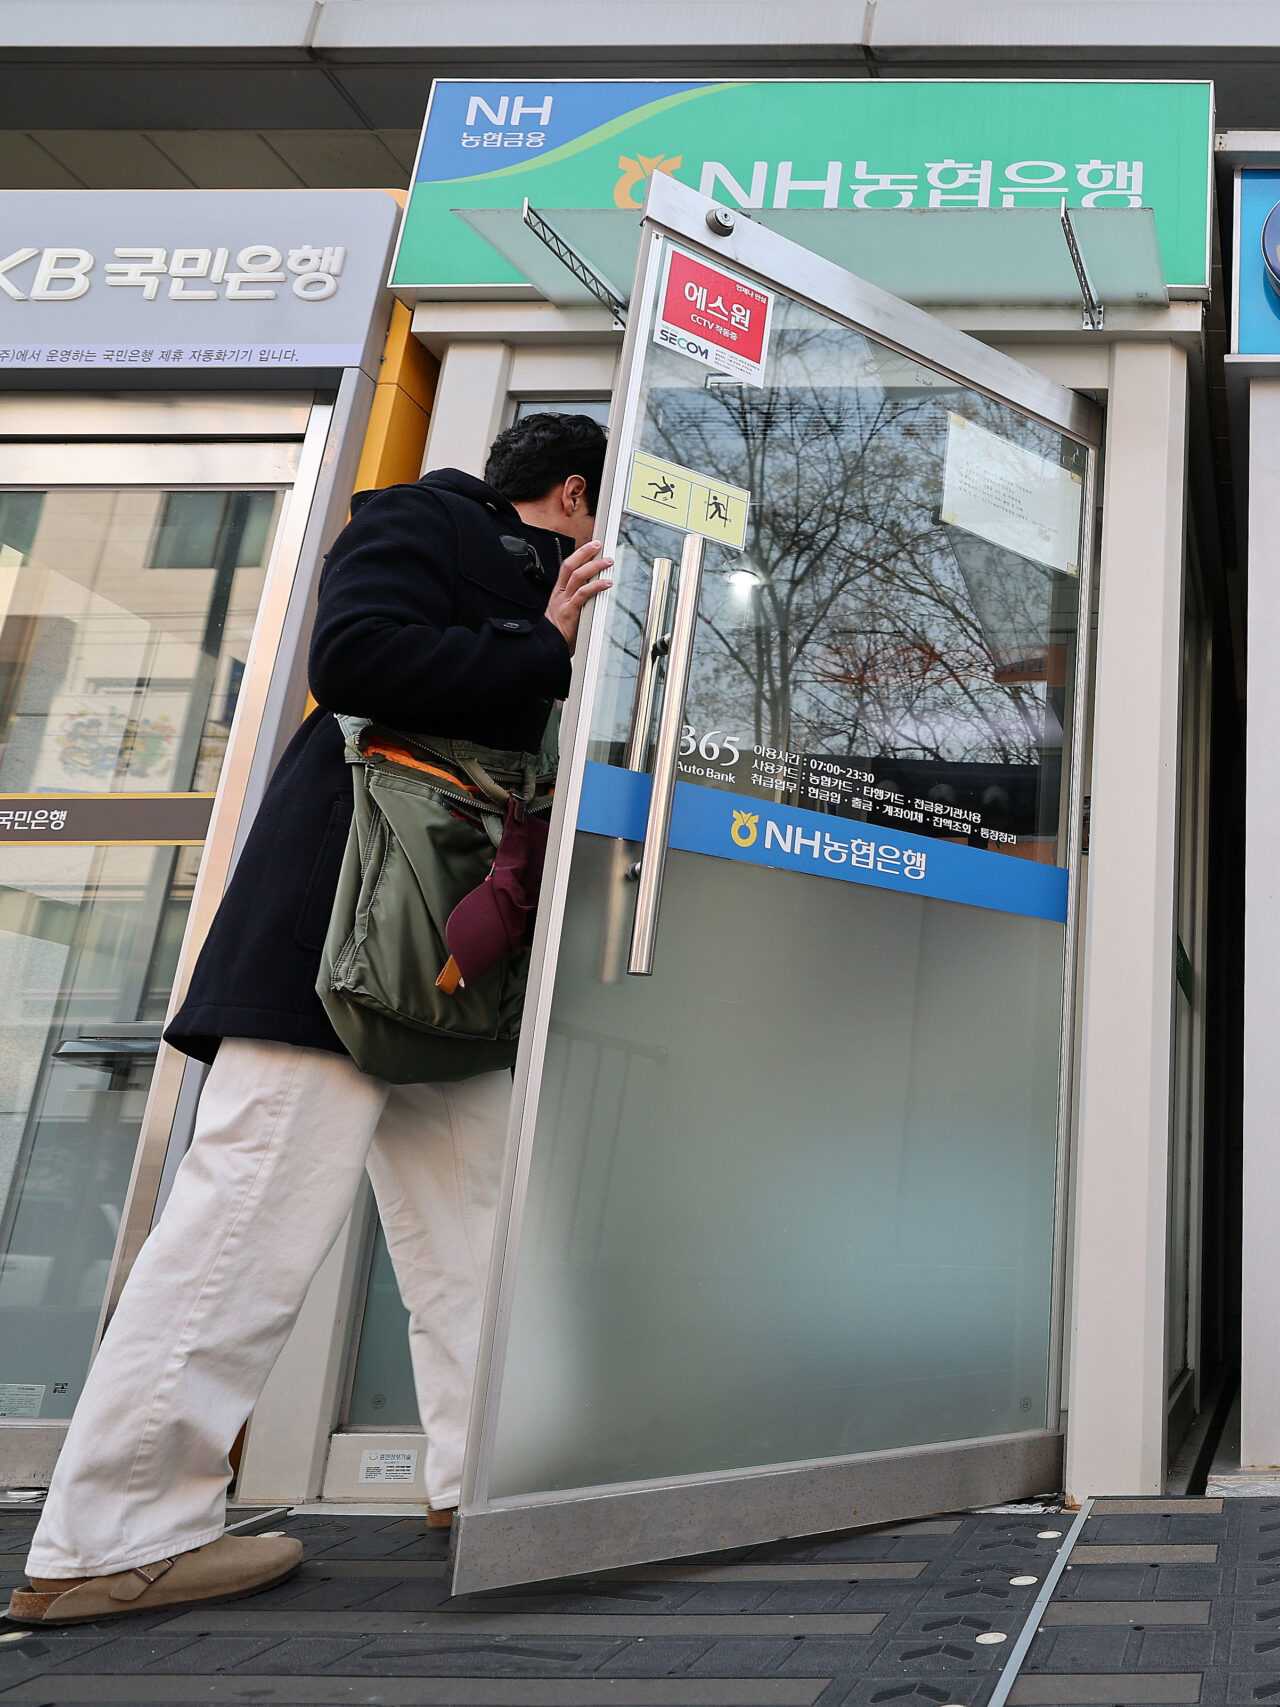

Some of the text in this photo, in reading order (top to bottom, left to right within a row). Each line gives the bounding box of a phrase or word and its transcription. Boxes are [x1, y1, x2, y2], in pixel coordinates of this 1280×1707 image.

[465, 96, 553, 126] NH
[461, 131, 546, 148] 농협금융
[104, 244, 346, 301] 국민은행
[684, 281, 751, 332] 에스원
[690, 313, 714, 330] CCTV
[46, 349, 97, 362] 운영하는
[102, 349, 154, 362] 국민은행
[158, 349, 184, 362] 제휴
[188, 349, 252, 362] 자동화기기
[258, 349, 300, 362] 입니다.
[659, 329, 709, 360] SECOM
[679, 725, 740, 767] 365
[706, 767, 736, 784] Bank
[754, 744, 875, 784] 이용시간 07:00~23:30
[752, 759, 799, 780] 사용카드
[808, 772, 853, 793] 농협카드
[863, 786, 905, 806] 타행카드
[0, 809, 68, 831] 국민은행
[751, 773, 797, 794] 취급업무
[882, 804, 924, 824] 계좌이체
[932, 815, 972, 835] 잔액조회
[764, 820, 927, 880] NH농협은행
